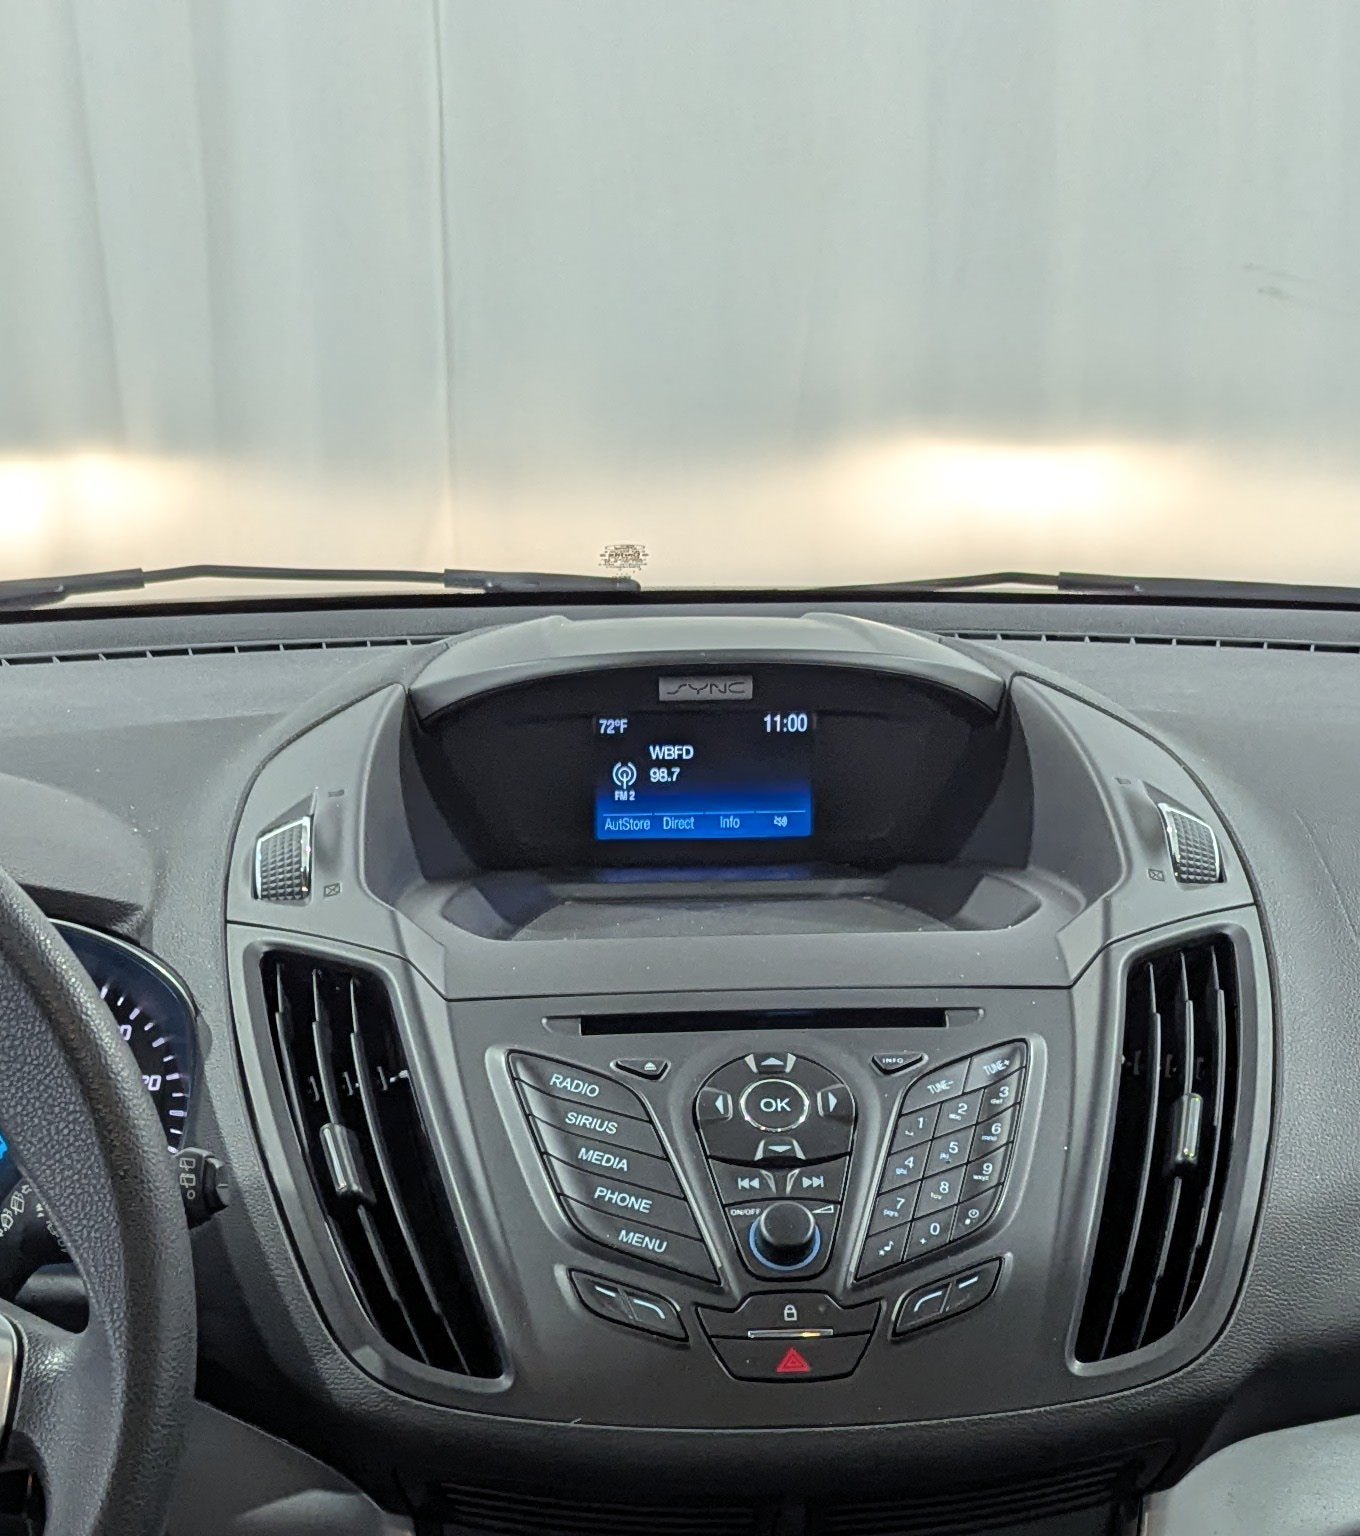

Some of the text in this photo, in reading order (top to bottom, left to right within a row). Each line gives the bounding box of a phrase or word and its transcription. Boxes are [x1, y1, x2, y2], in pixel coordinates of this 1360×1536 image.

[666, 681, 745, 695] SYNC
[763, 712, 808, 733] 11:00
[649, 745, 695, 760] WBFD
[649, 767, 680, 782] 98.7
[615, 791, 628, 801] FM
[605, 817, 651, 831] AutStore
[663, 816, 695, 830] Direct
[720, 815, 740, 829] Info
[549, 1074, 600, 1097] RADIO
[999, 1086, 1009, 1097] 3
[760, 1097, 792, 1112] OK
[958, 1103, 968, 1115] 2
[565, 1112, 618, 1135] SIRIUS
[917, 1117, 924, 1129] 1
[991, 1123, 1001, 1134] 6
[948, 1142, 959, 1153] 5
[578, 1148, 628, 1172] MEDIA
[905, 1156, 915, 1169] 4
[982, 1163, 993, 1174] 9
[939, 1181, 950, 1193] 8
[594, 1187, 652, 1213] PHONE
[896, 1198, 905, 1210] 7
[730, 1208, 761, 1216] ON/OFF
[930, 1223, 940, 1235] 0
[618, 1230, 667, 1253] MENU
